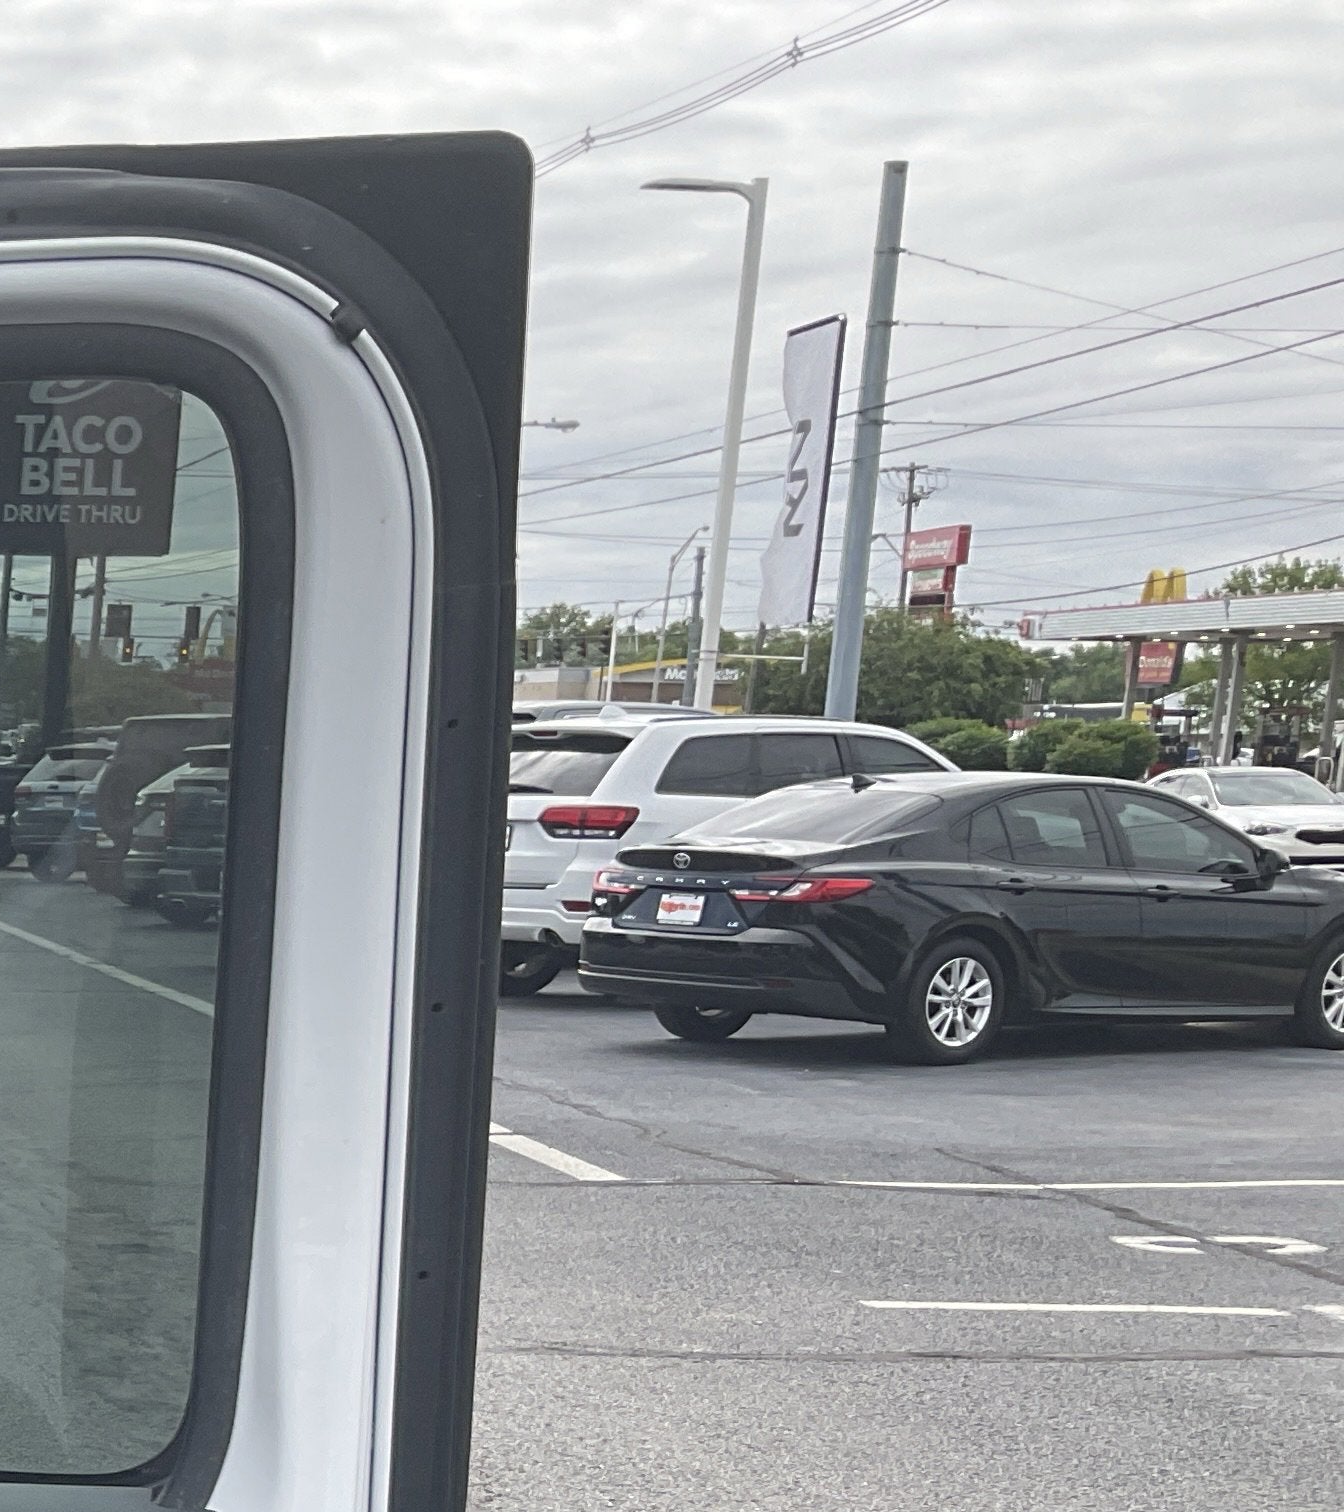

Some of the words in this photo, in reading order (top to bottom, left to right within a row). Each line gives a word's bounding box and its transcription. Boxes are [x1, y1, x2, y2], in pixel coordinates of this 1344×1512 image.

[15, 414, 143, 455] TACO
[19, 457, 138, 497] BELL
[2, 503, 71, 523] DRIVE
[78, 504, 141, 524] THRU
